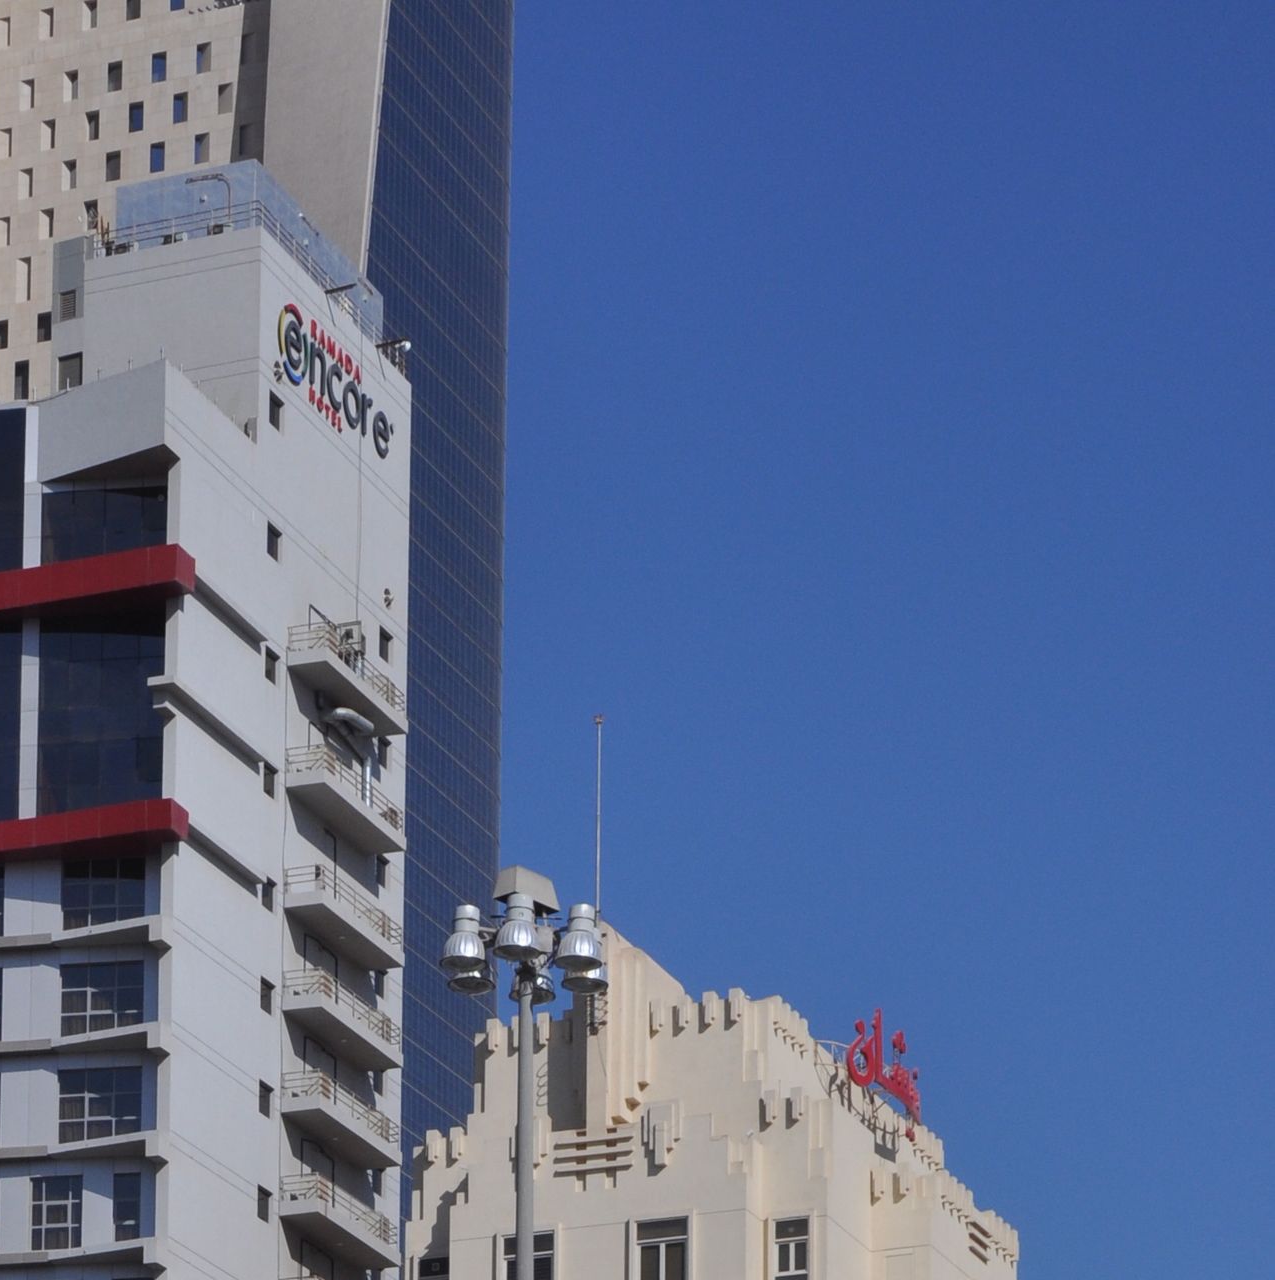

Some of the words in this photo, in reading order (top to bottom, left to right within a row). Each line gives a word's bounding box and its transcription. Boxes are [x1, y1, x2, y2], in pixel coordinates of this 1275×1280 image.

[280, 310, 391, 460] encore
[310, 318, 363, 385] RAMADA
[308, 385, 343, 434] HOTEL
